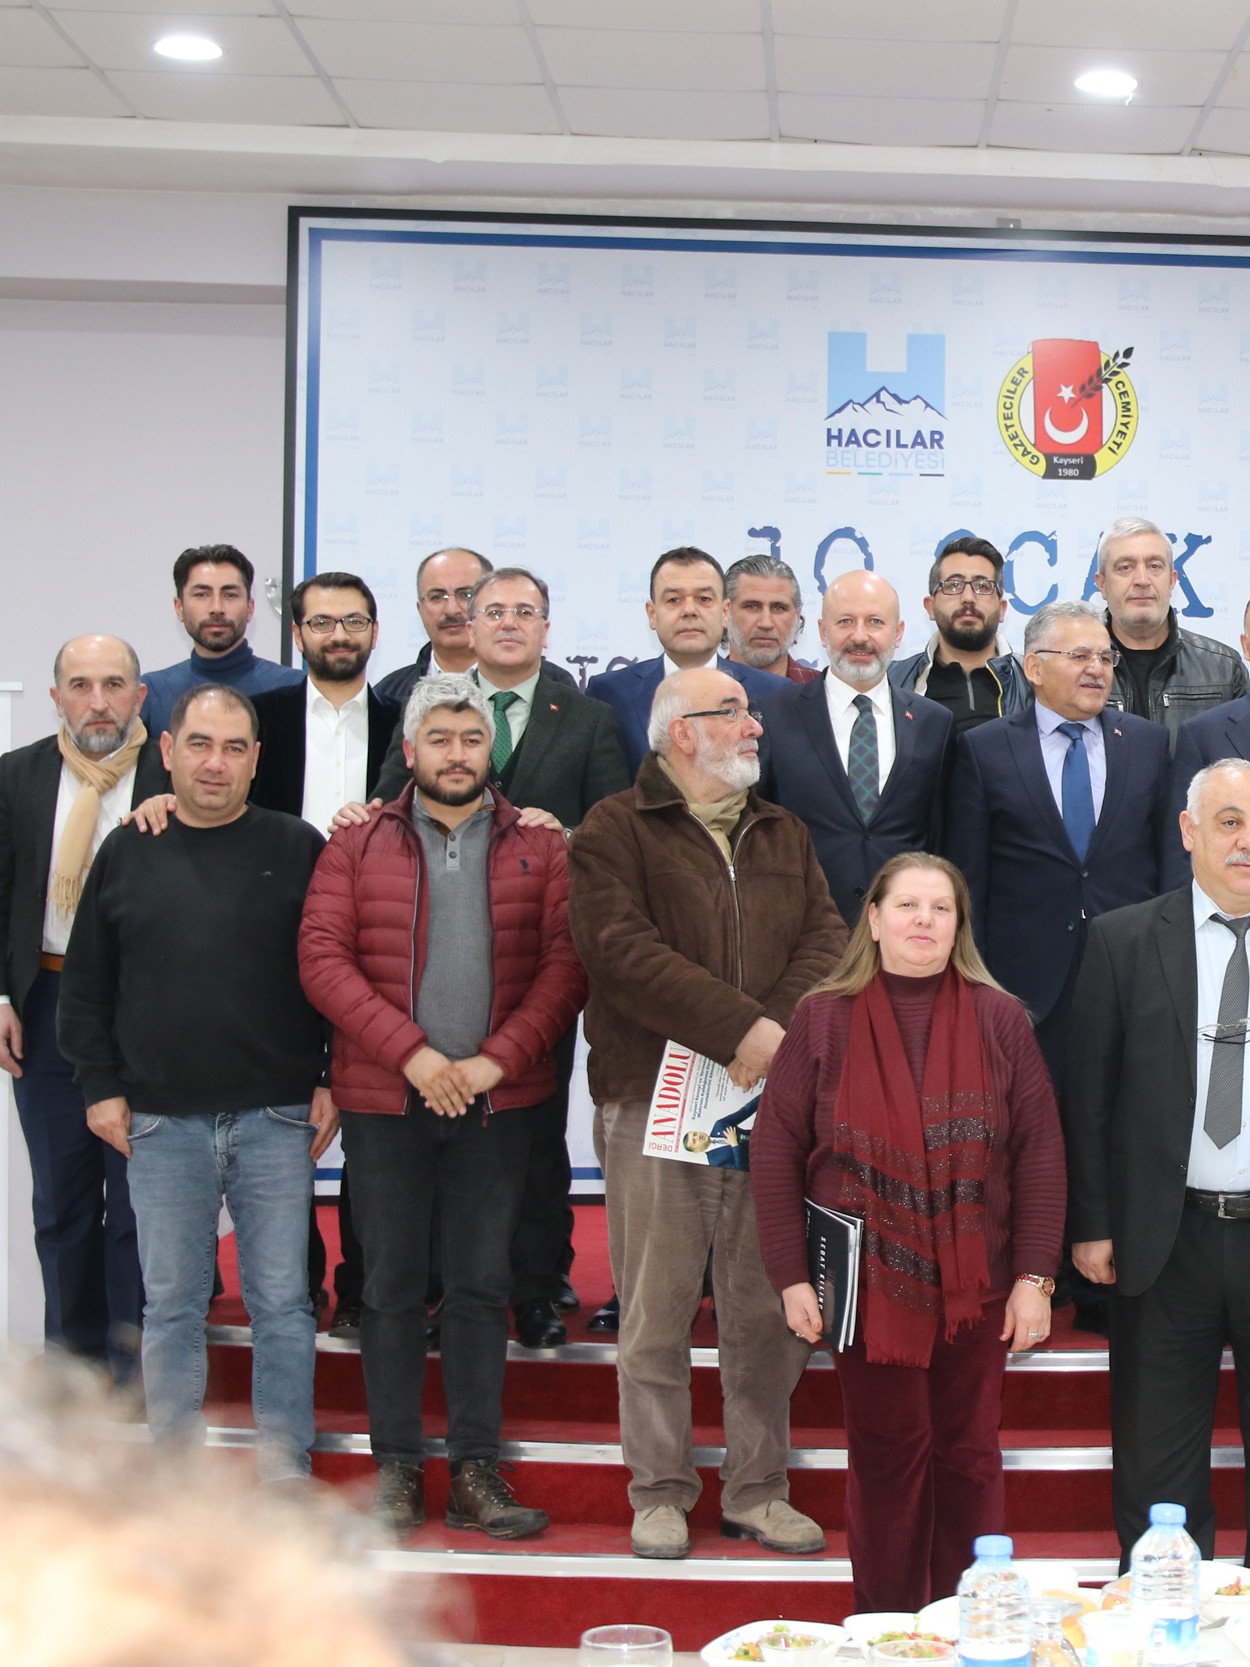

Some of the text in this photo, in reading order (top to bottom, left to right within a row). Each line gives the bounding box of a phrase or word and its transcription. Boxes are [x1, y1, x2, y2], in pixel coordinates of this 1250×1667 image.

[1002, 366, 1040, 466] GAZETECİLER
[826, 428, 944, 450] HACILAR
[1053, 456, 1084, 467] Kayseri
[1057, 468, 1080, 477] 1980
[651, 1046, 692, 1143] ANADOLU
